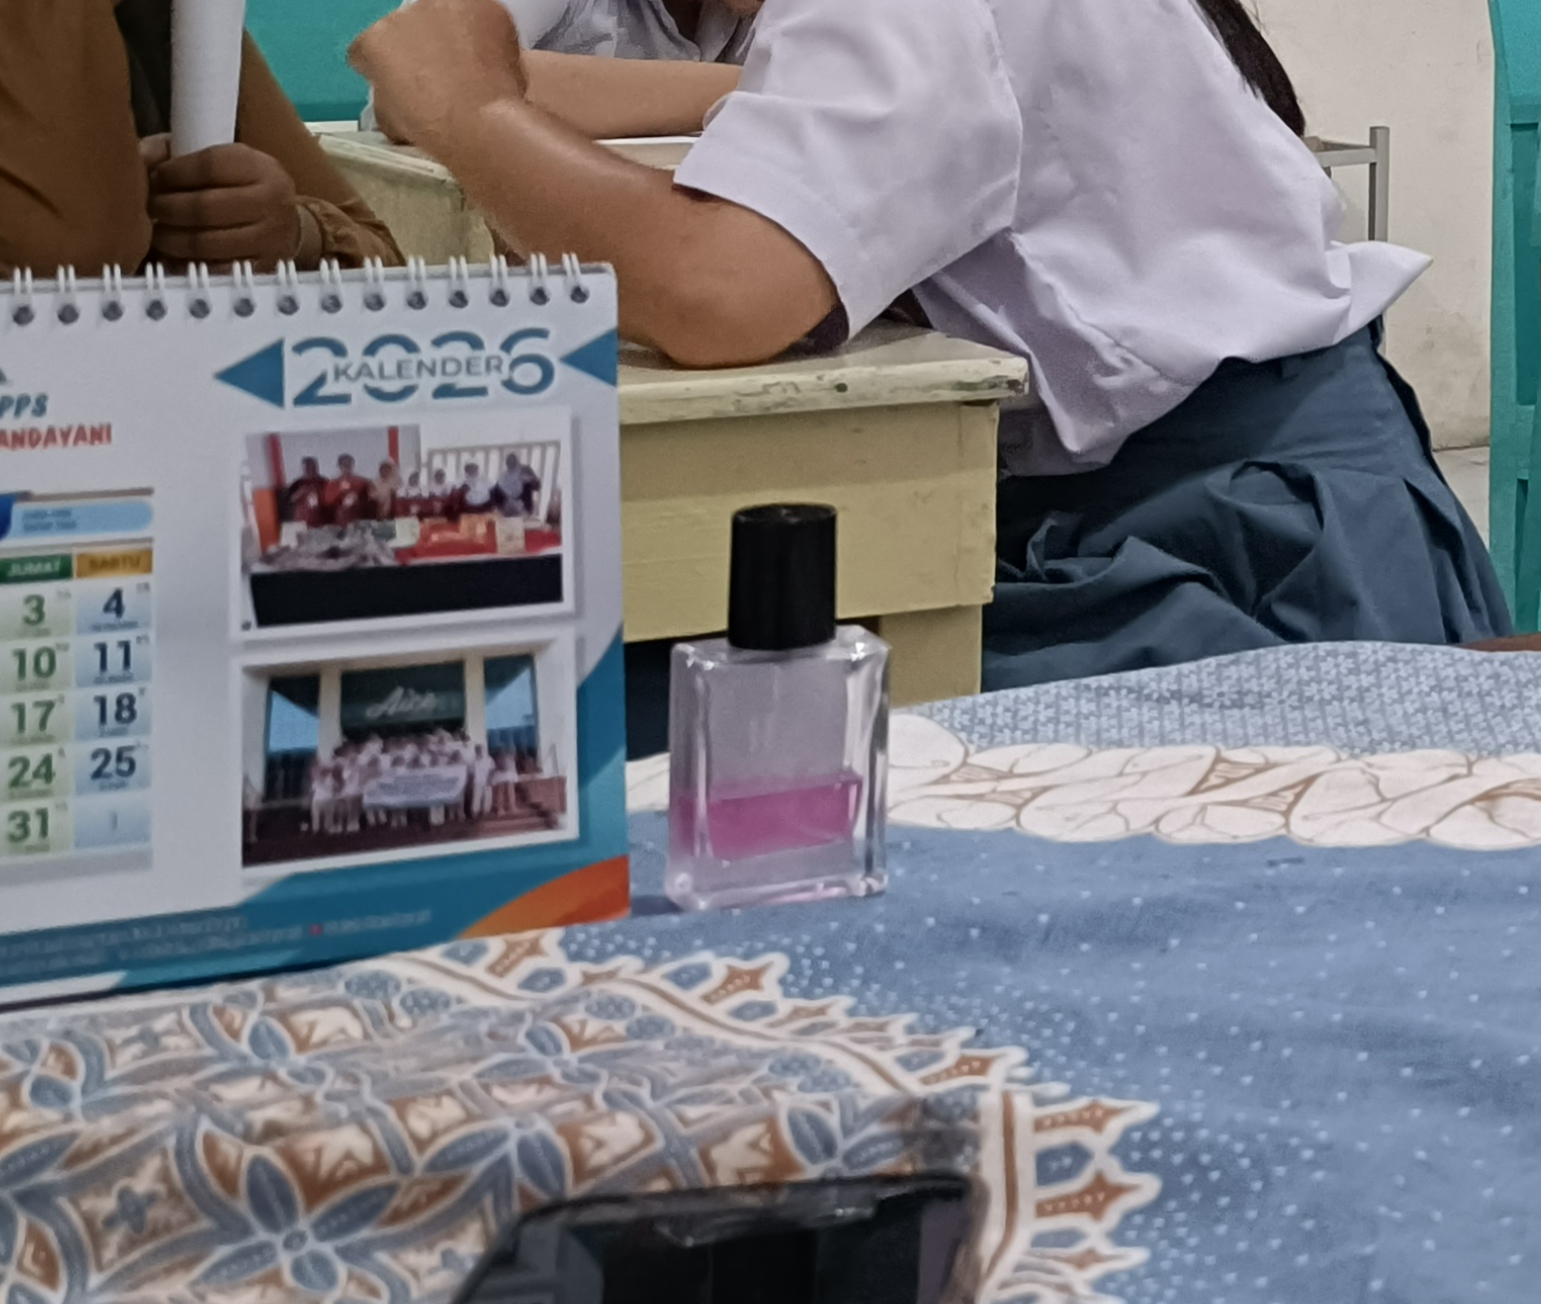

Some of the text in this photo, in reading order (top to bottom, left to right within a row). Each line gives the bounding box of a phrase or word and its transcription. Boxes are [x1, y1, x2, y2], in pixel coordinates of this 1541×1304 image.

[292, 326, 556, 408] 2026
[333, 354, 504, 384] KALENDER
[22, 587, 126, 627] 3 4
[13, 640, 132, 681] 10 11
[11, 692, 138, 734] 17 18
[8, 745, 137, 789] 24 25
[7, 807, 50, 844] 31
